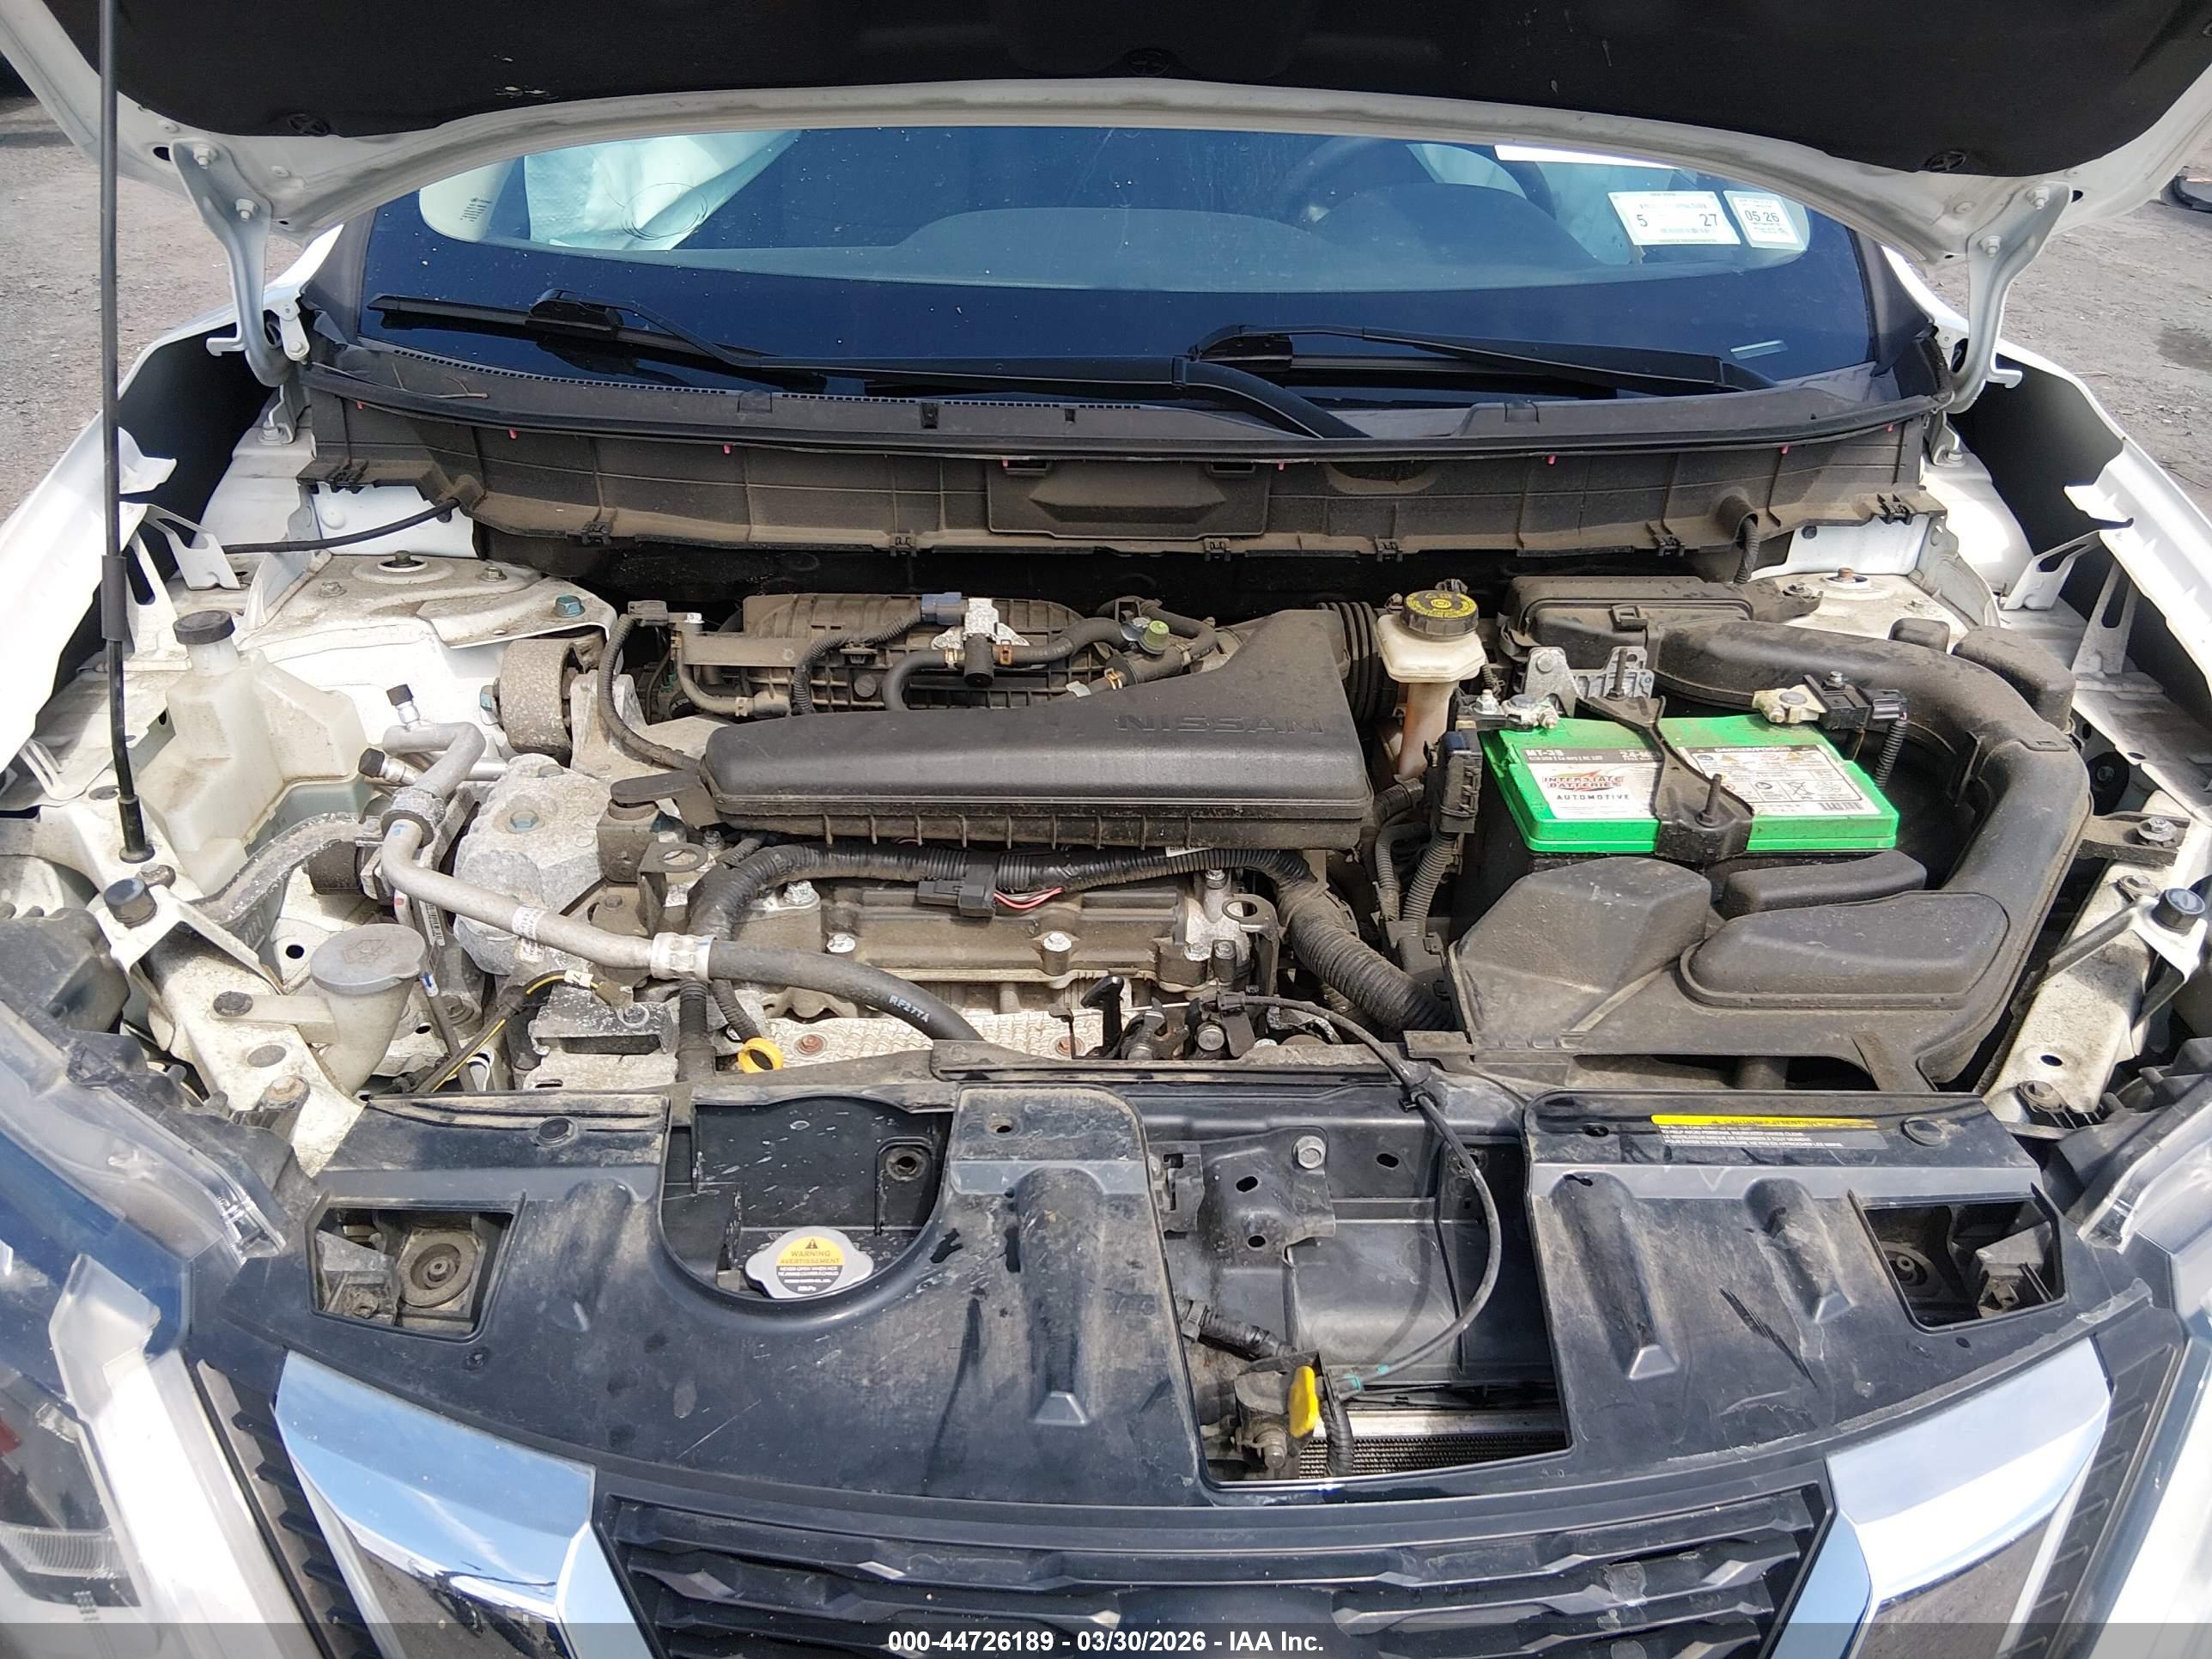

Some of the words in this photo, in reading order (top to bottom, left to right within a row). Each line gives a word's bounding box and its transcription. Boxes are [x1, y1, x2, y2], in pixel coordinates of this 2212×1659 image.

[1636, 214, 1648, 227] 5
[1698, 213, 1717, 227] 27
[1744, 210, 1760, 222] 05
[1763, 211, 1780, 222] 26
[1116, 714, 1324, 734] NISSAN
